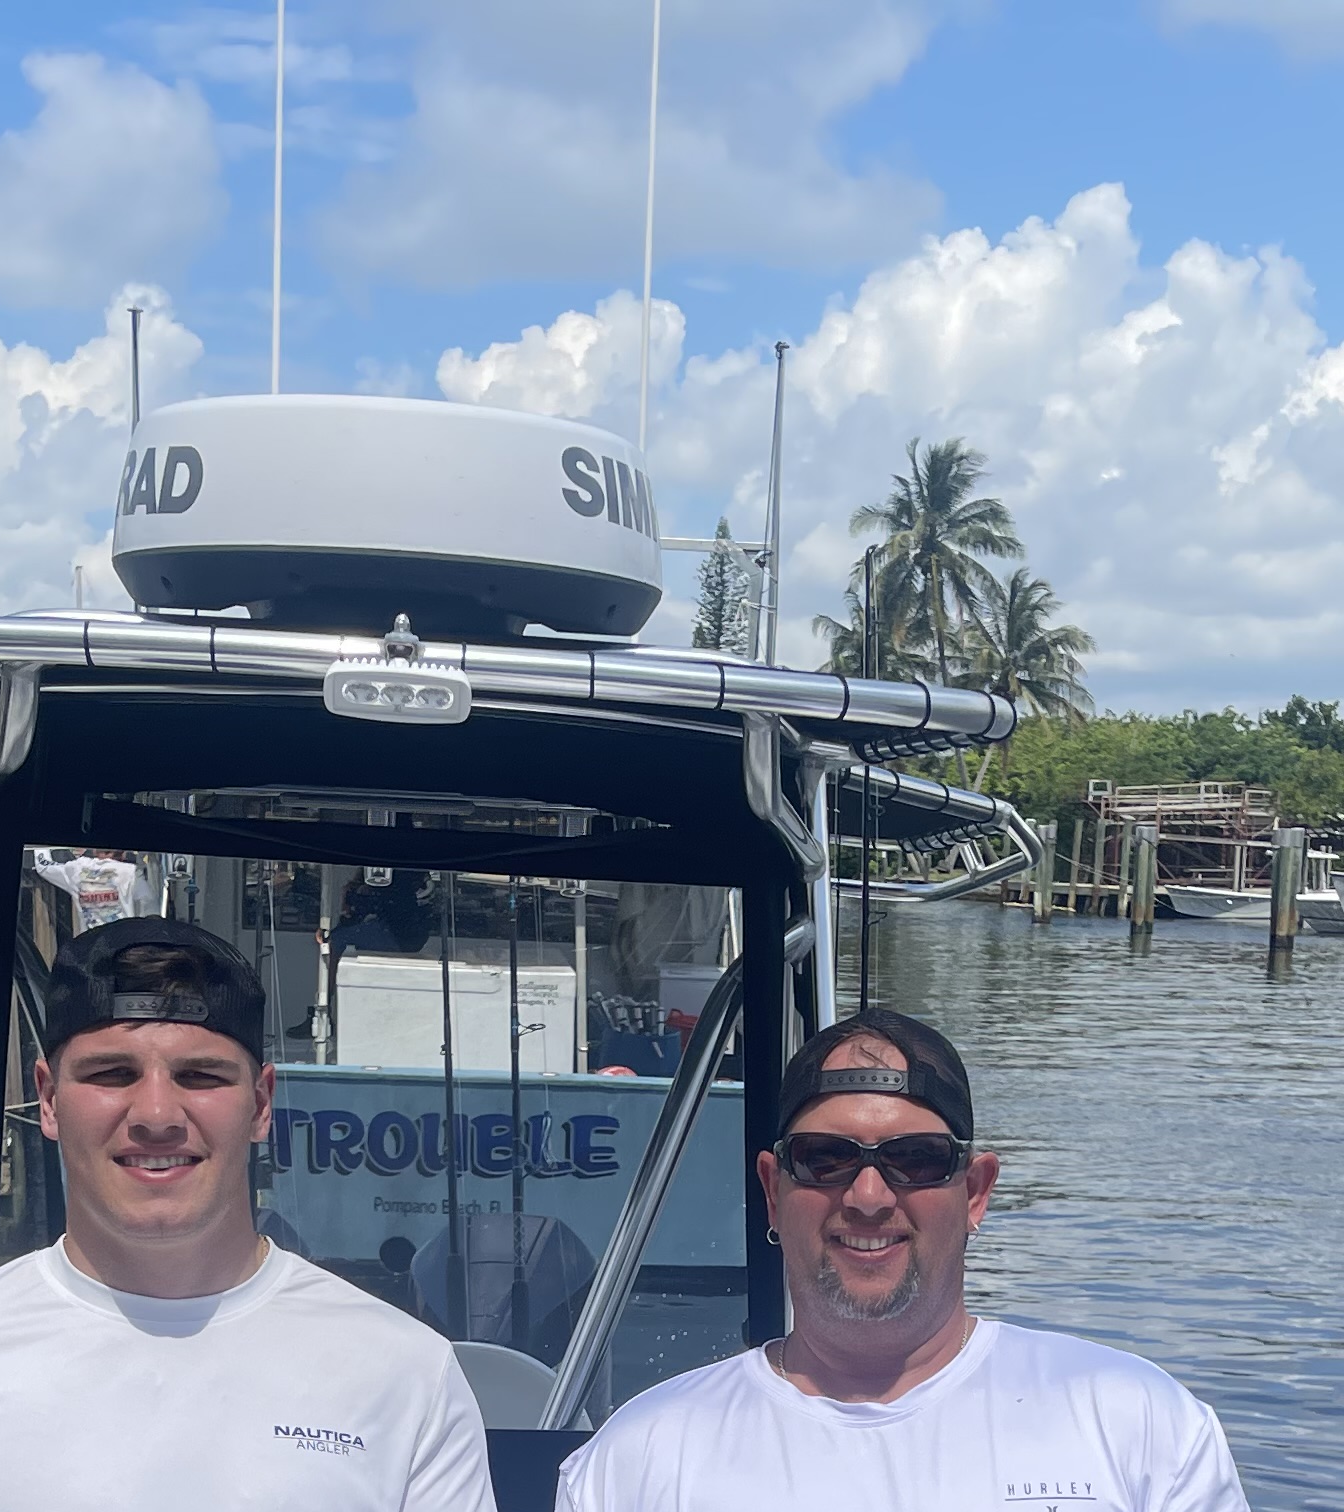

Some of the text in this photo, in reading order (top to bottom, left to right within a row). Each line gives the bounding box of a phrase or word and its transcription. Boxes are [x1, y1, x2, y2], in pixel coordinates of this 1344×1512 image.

[270, 1107, 621, 1179] TROUBLE
[374, 1196, 437, 1217] Pompano
[274, 1425, 364, 1448] NAUTICA
[296, 1439, 350, 1456] ANGLER
[1007, 1482, 1092, 1496] HURLEY
